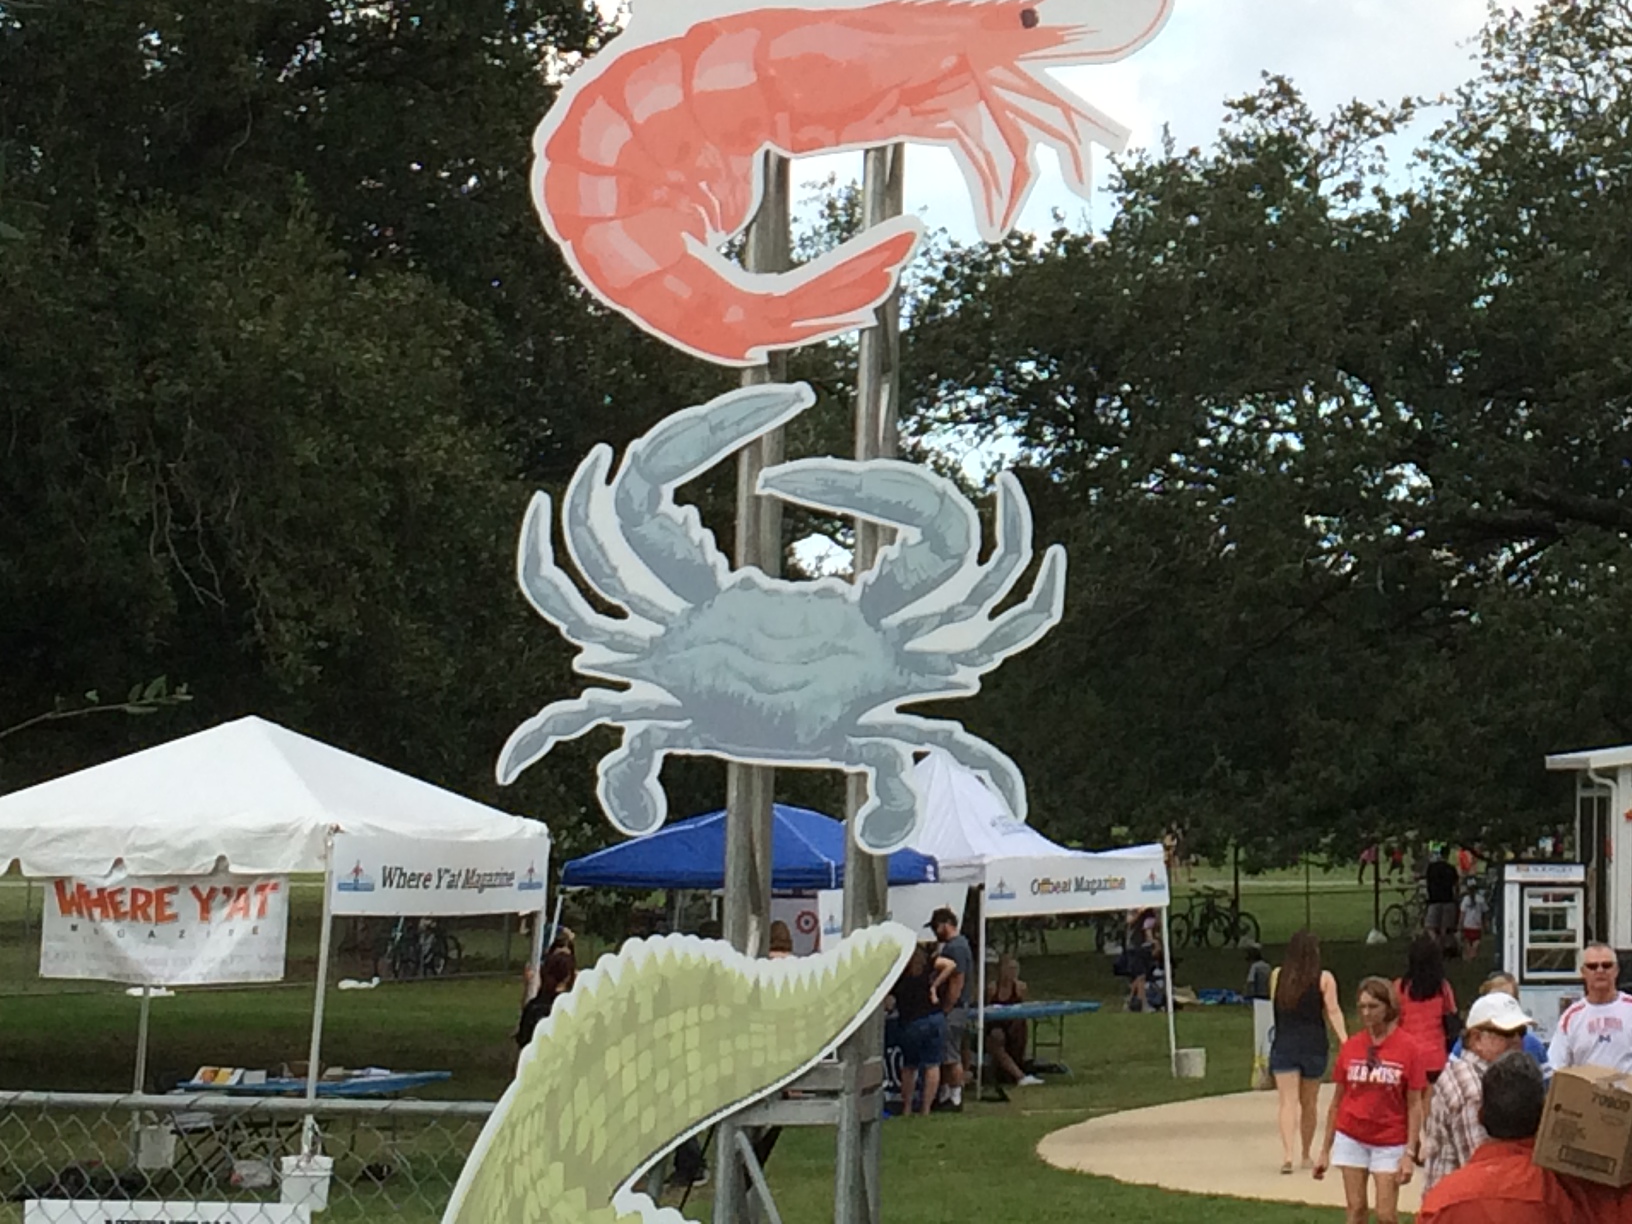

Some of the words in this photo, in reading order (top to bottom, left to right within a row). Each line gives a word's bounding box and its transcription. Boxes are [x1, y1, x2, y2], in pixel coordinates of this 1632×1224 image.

[381, 865, 434, 889] Where
[54, 878, 181, 925] WHERE
[189, 881, 281, 923] Y'AT
